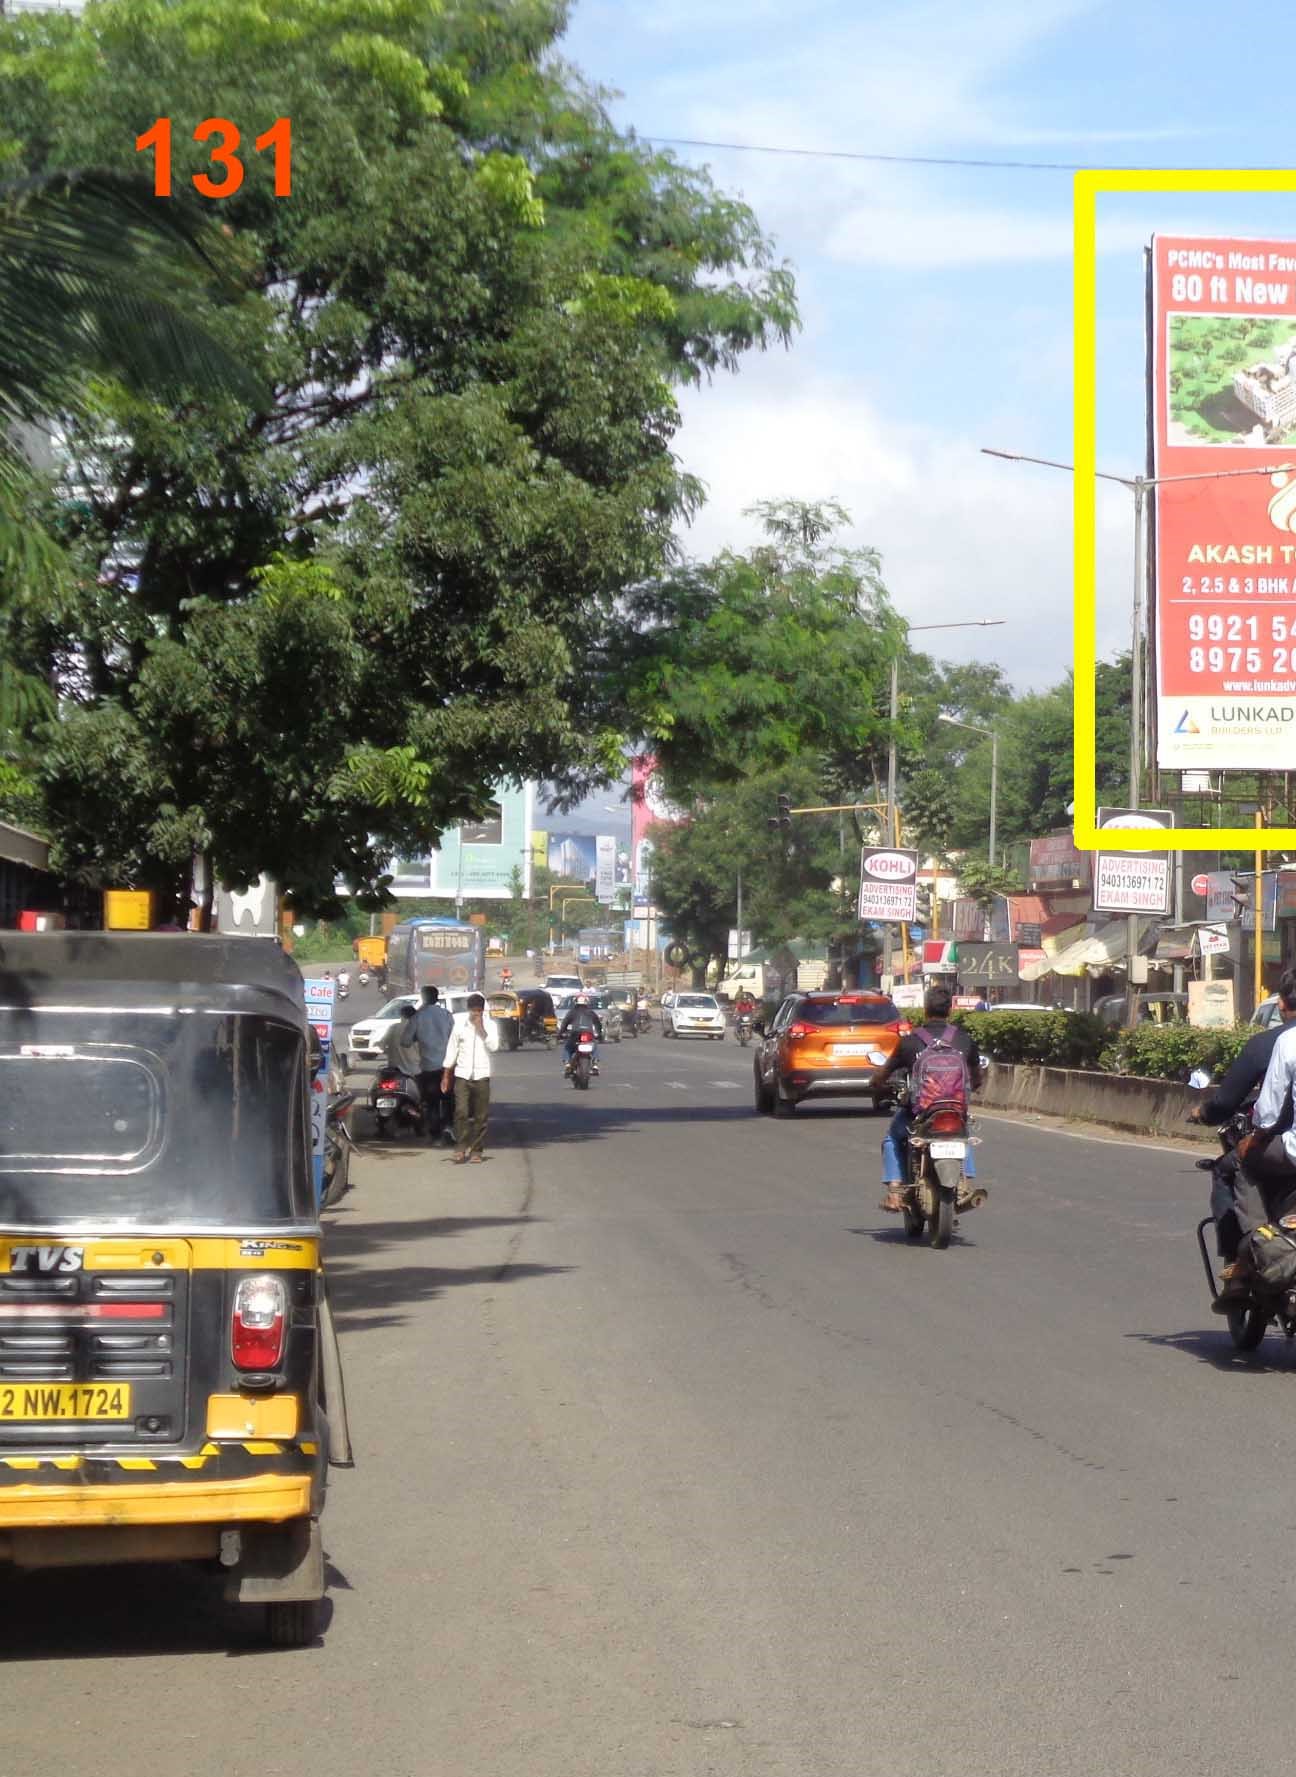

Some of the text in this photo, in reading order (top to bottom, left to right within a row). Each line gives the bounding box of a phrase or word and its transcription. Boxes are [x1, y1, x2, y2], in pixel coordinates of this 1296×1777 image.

[1168, 249, 1224, 269] PCMC's
[1228, 252, 1265, 271] Most
[1171, 274, 1203, 303] 80
[1210, 275, 1228, 304] ft
[1235, 277, 1289, 305] New
[1188, 545, 1272, 564] AKASH
[1182, 576, 1196, 595] 2,
[1201, 577, 1224, 593] 2.5
[1228, 577, 1240, 593] &
[1244, 577, 1254, 594] 3
[1258, 577, 1288, 594] BHK
[1188, 614, 1259, 641] 9921
[1189, 647, 1262, 673] 8975
[1211, 705, 1295, 722] LUNKAD
[868, 859, 911, 874] KOHLI
[1101, 858, 1166, 874] ADVERTISING
[863, 883, 913, 896] ADVERTISING
[1132, 892, 1164, 906] SINGH
[888, 907, 912, 919] SINGH
[10, 1246, 84, 1272] TVS
